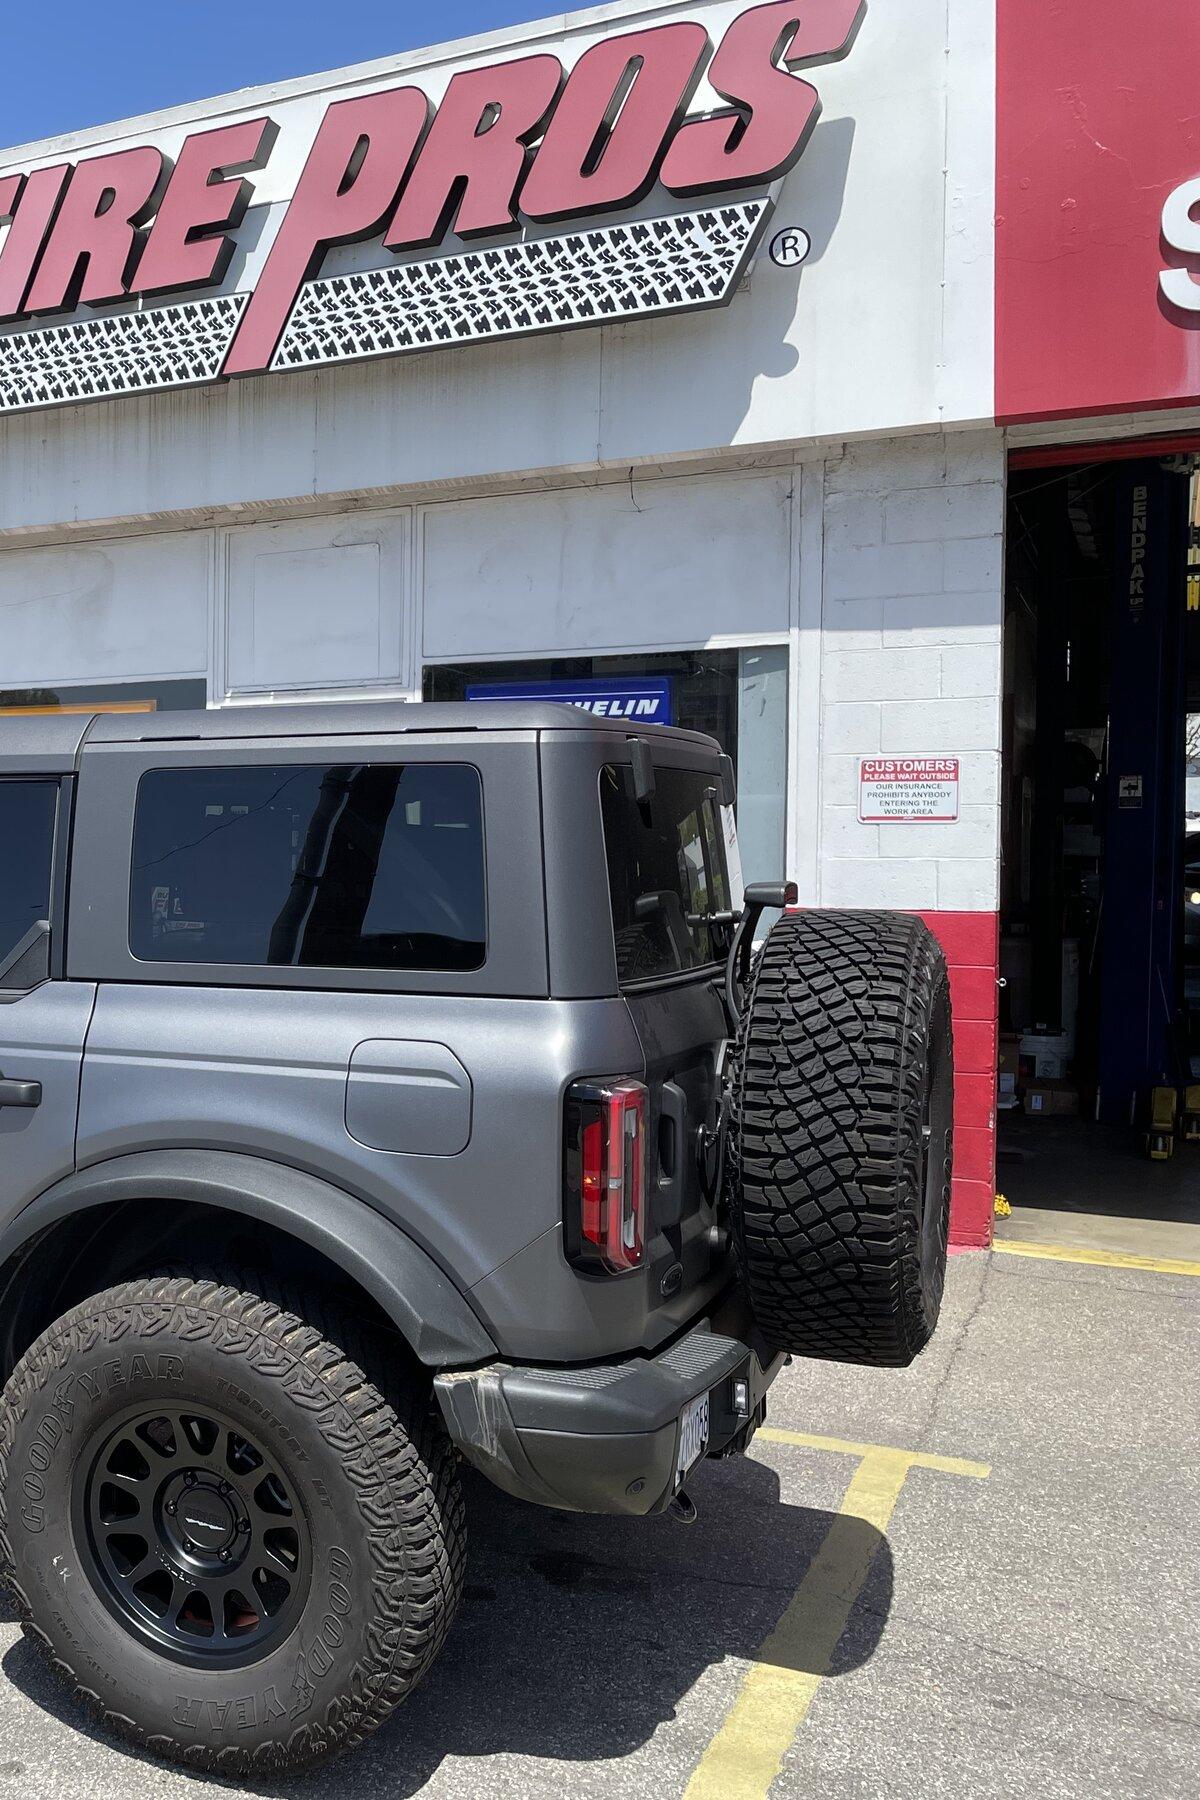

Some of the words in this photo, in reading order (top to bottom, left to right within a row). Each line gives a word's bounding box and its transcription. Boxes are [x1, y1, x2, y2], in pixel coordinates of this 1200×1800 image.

[224, 0, 866, 378] PROS
[1130, 486, 1147, 595] BENDPAK
[564, 698, 660, 716] HELIN
[866, 761, 955, 771] CUSTOMERS
[919, 772, 955, 780] OUTSIDE
